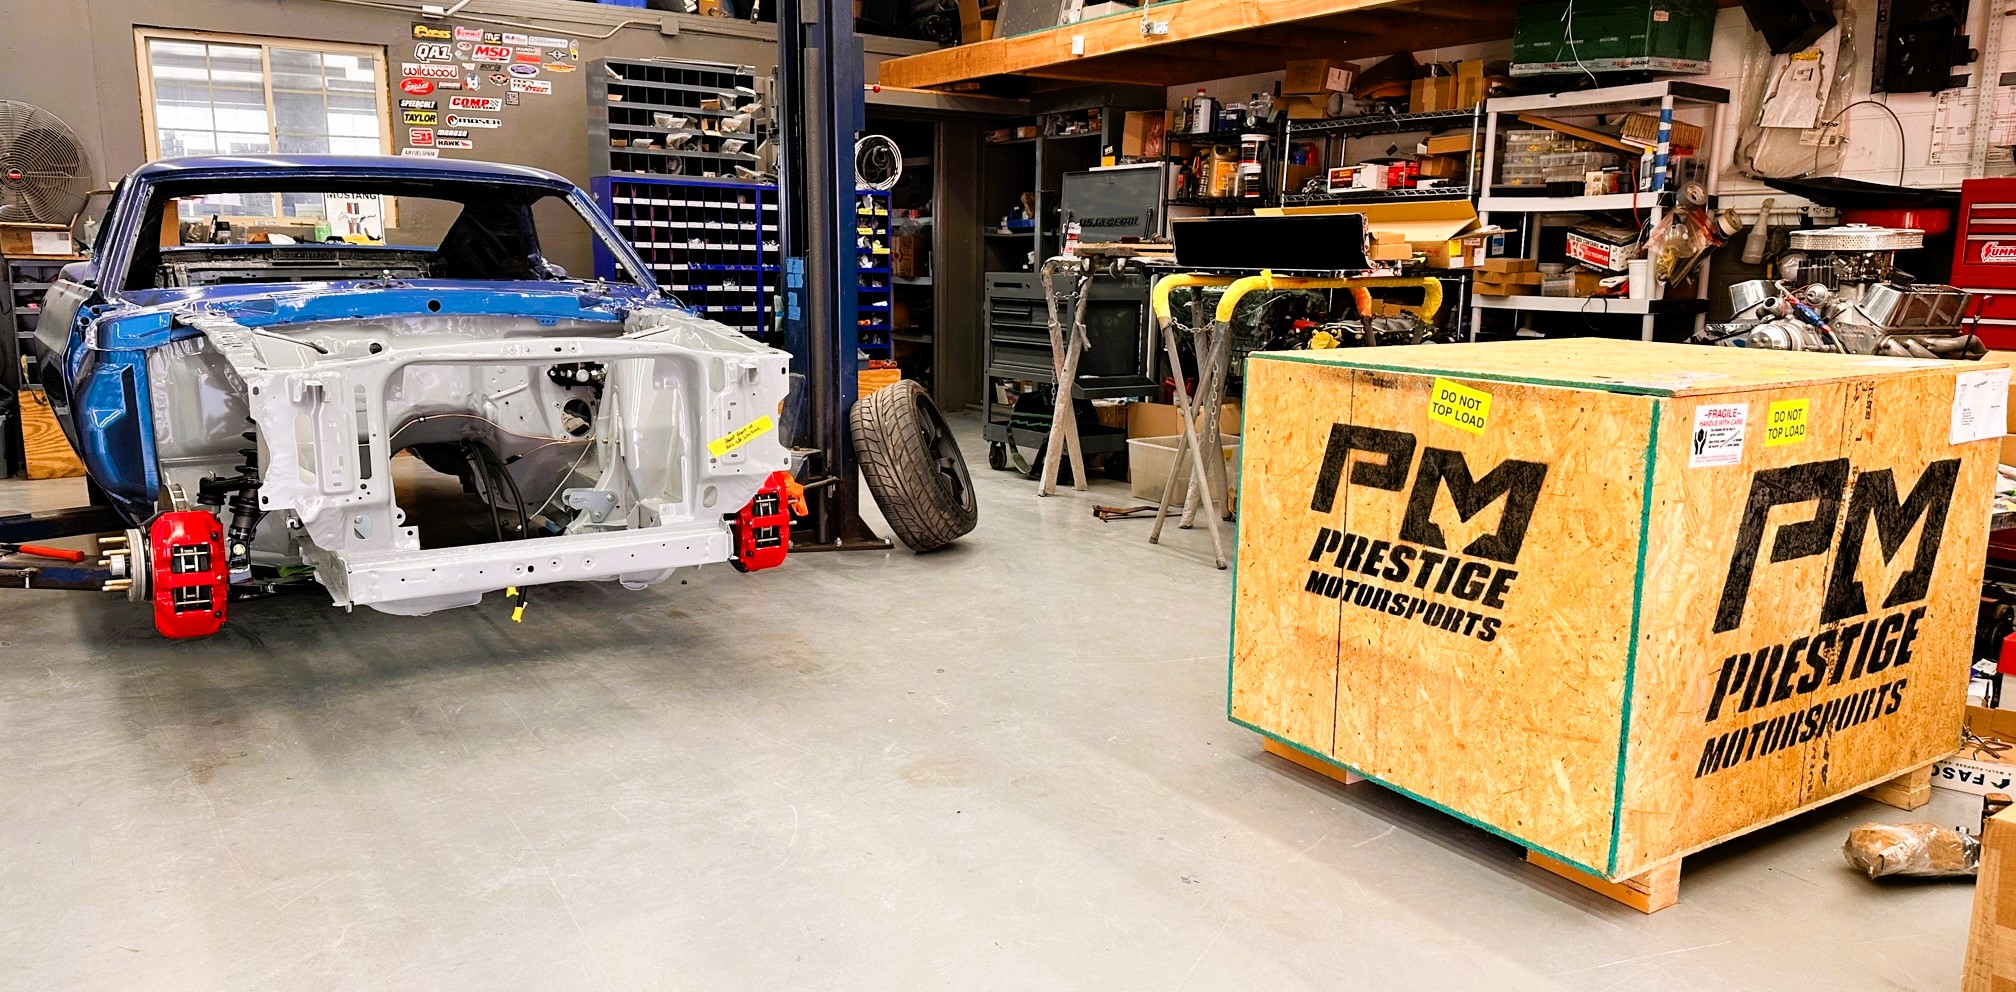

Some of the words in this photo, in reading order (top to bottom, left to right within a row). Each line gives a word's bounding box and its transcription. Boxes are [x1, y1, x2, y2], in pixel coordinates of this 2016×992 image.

[416, 44, 451, 61] QA1
[475, 45, 511, 57] MSD
[404, 65, 457, 77] wilwood
[452, 97, 490, 107] COMP
[405, 113, 436, 122] TAYLOR
[1440, 389, 1457, 403] DO
[1459, 394, 1482, 411] NOT
[1432, 401, 1453, 417] TOP
[1454, 410, 1485, 429] LOAD
[1699, 419, 1718, 427] HANDLE
[1718, 418, 1730, 426] WITH
[1730, 418, 1743, 426] CARE
[1774, 411, 1785, 423] DO
[1786, 408, 1803, 420] NOT
[1768, 428, 1783, 440] TOP
[1784, 424, 1805, 438] LOAD
[1310, 422, 1549, 565] PM
[1713, 457, 1962, 634] PM
[1308, 527, 1519, 610] PRESTIGE
[1304, 570, 1503, 642] MOTORSPORTS
[1705, 606, 1927, 723] PRESTIGE
[1694, 678, 1907, 779] MOTORSPORTS
